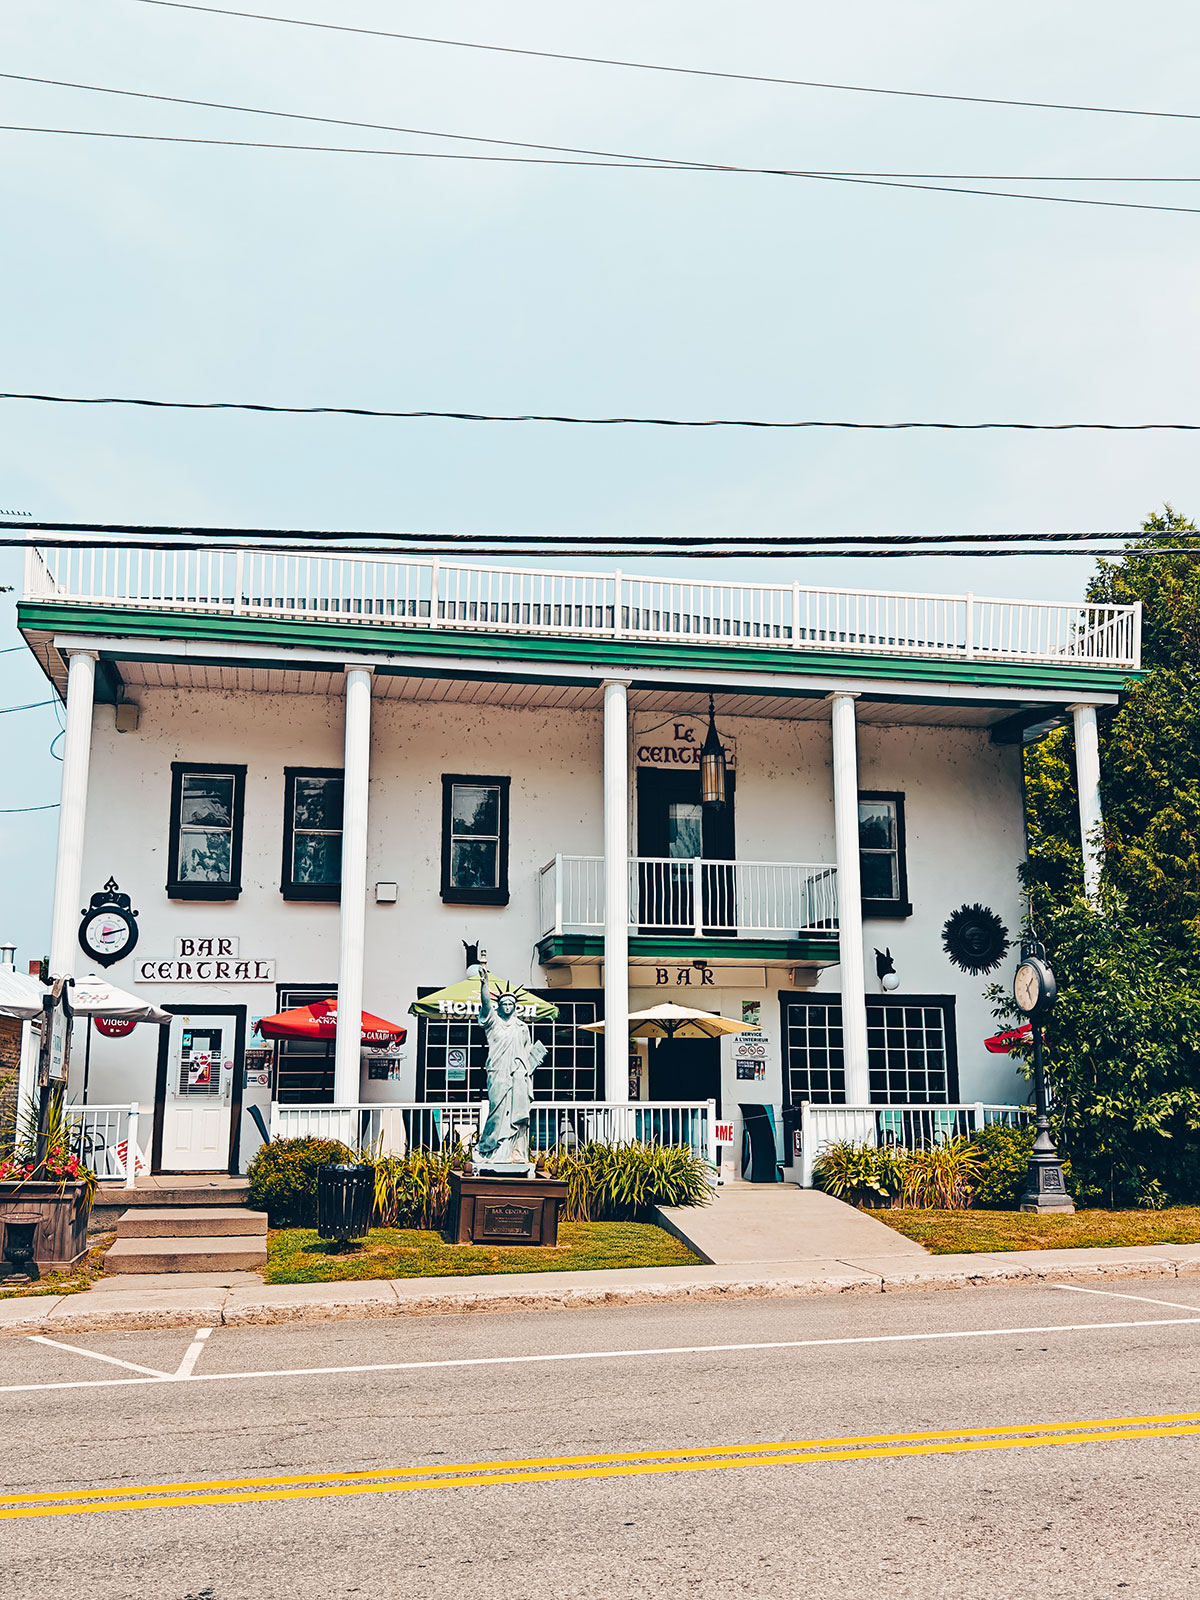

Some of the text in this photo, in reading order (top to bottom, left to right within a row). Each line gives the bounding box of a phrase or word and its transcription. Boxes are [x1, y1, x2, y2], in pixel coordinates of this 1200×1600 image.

[636, 746, 737, 765] CENTRL
[179, 938, 233, 957] BAR
[141, 961, 270, 980] CENTRAL
[656, 968, 715, 985] BAR
[437, 1000, 538, 1018] Heinen
